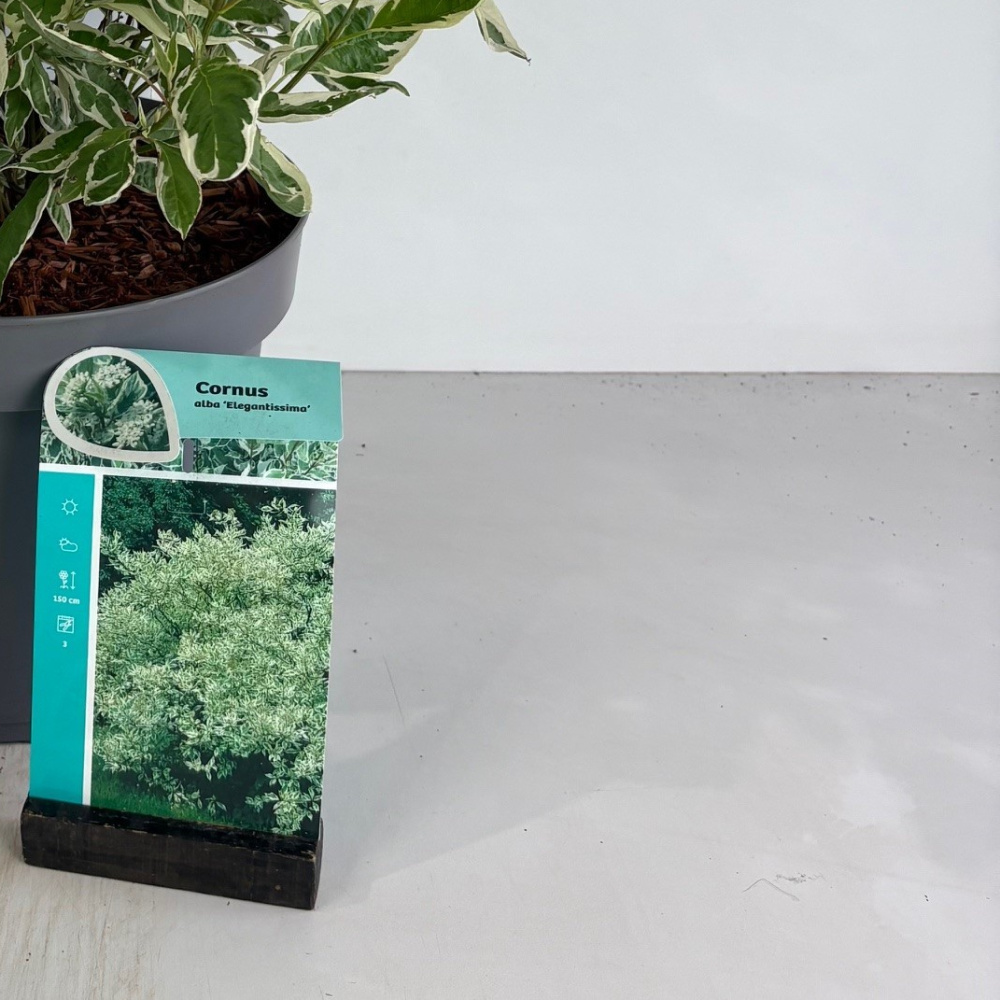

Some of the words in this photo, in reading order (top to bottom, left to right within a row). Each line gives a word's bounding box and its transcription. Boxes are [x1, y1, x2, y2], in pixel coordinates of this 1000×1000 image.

[195, 381, 268, 398] Cornus
[194, 400, 220, 408] alba
[53, 595, 67, 603] 150
